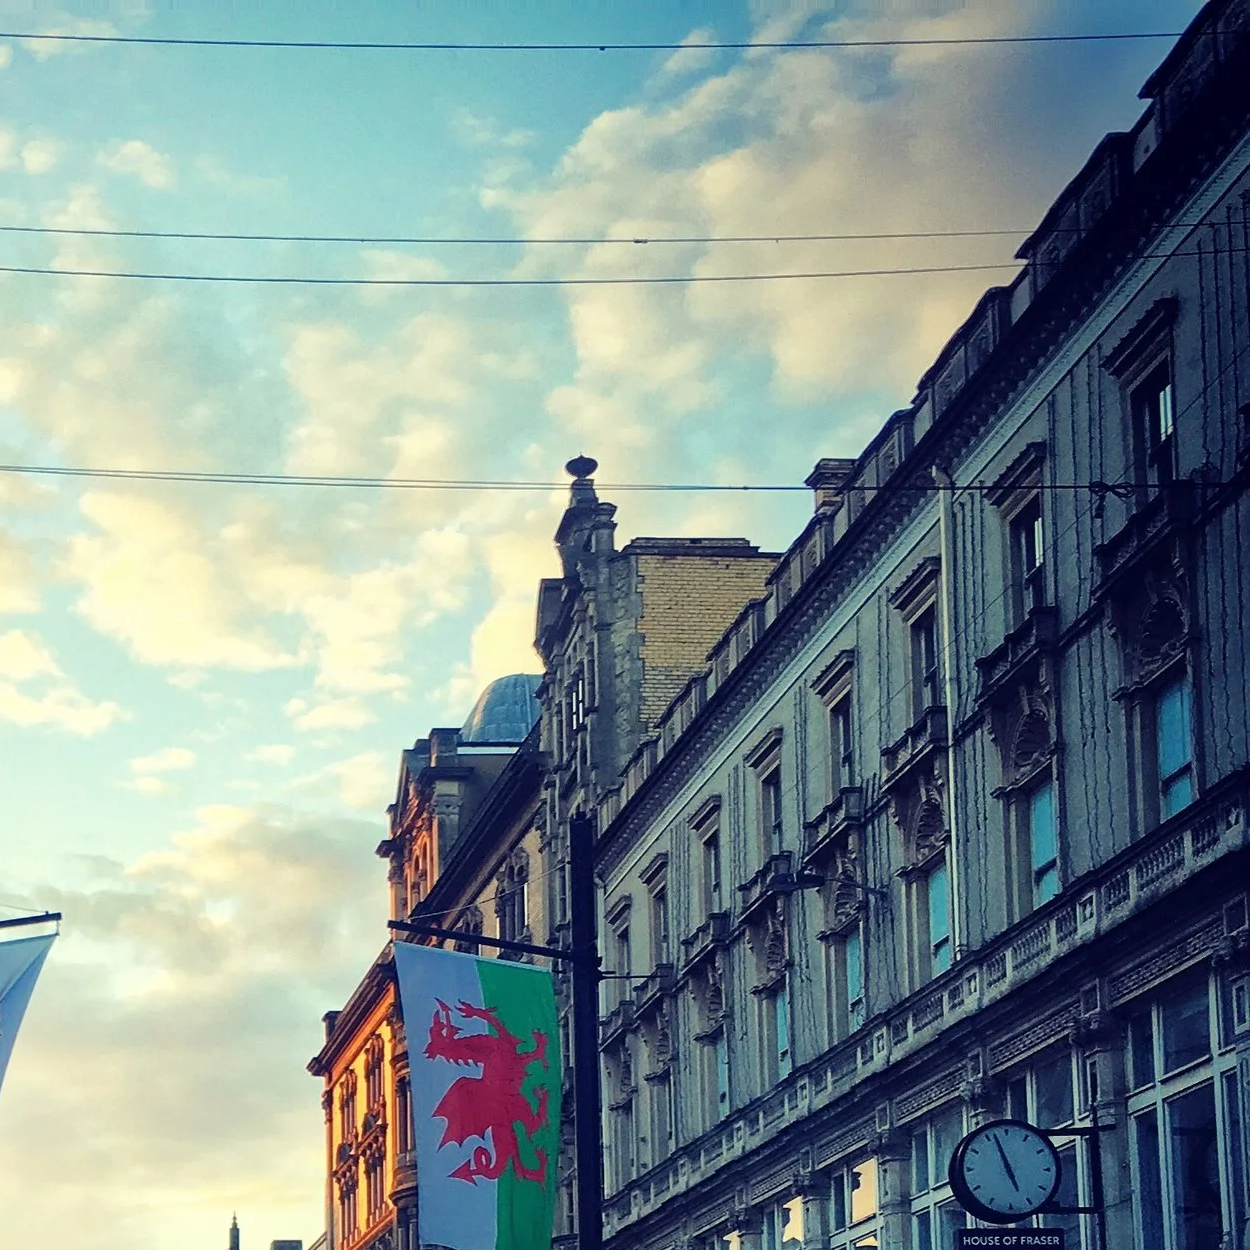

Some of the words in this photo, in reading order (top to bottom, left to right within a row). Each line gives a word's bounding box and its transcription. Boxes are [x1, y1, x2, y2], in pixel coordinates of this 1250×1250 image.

[963, 1236, 1000, 1246] HOUSE
[1003, 1236, 1018, 1246] OF
[1020, 1236, 1060, 1246] FRASER
